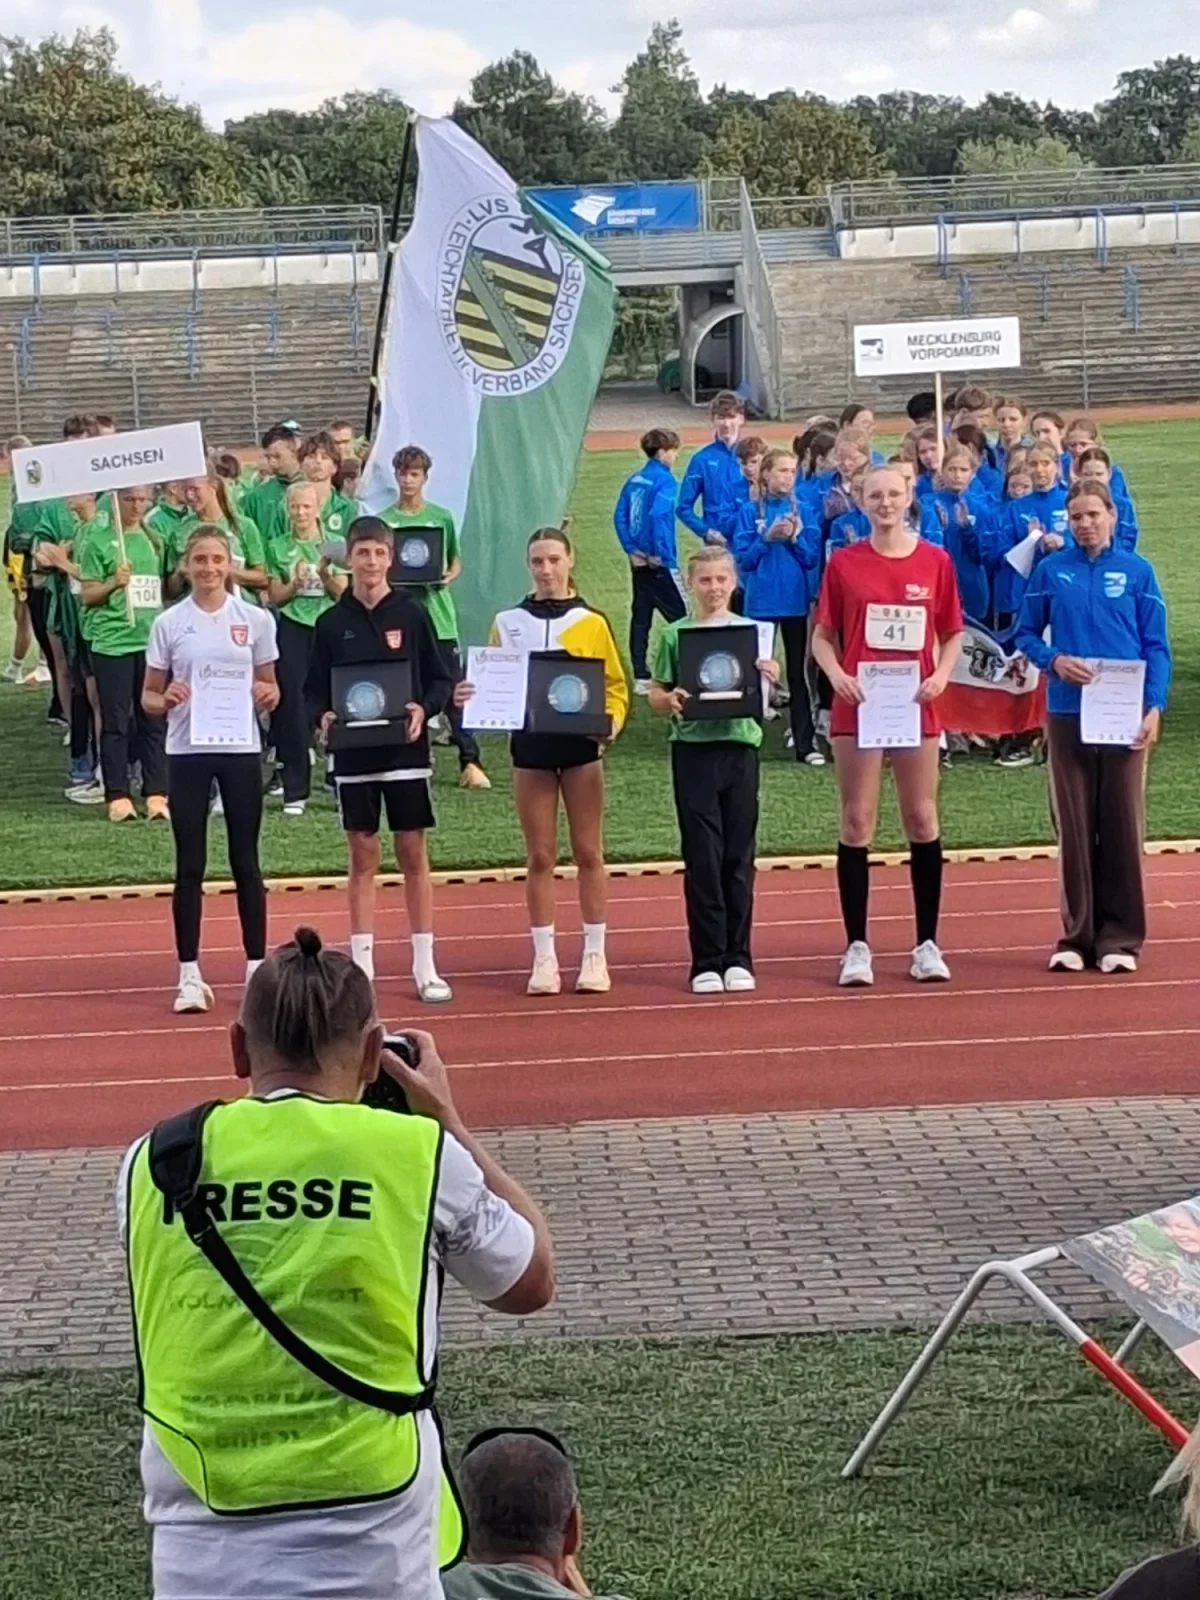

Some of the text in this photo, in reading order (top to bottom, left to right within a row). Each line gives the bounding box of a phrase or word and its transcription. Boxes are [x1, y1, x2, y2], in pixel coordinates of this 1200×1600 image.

[470, 198, 509, 222] LVS
[550, 254, 583, 350] SACHSEN
[907, 330, 1002, 347] MECKLENBURG
[909, 344, 1001, 361] VORPOMMERN
[90, 448, 164, 472] SACHSEN
[133, 590, 157, 602] 104
[883, 624, 907, 642] 41
